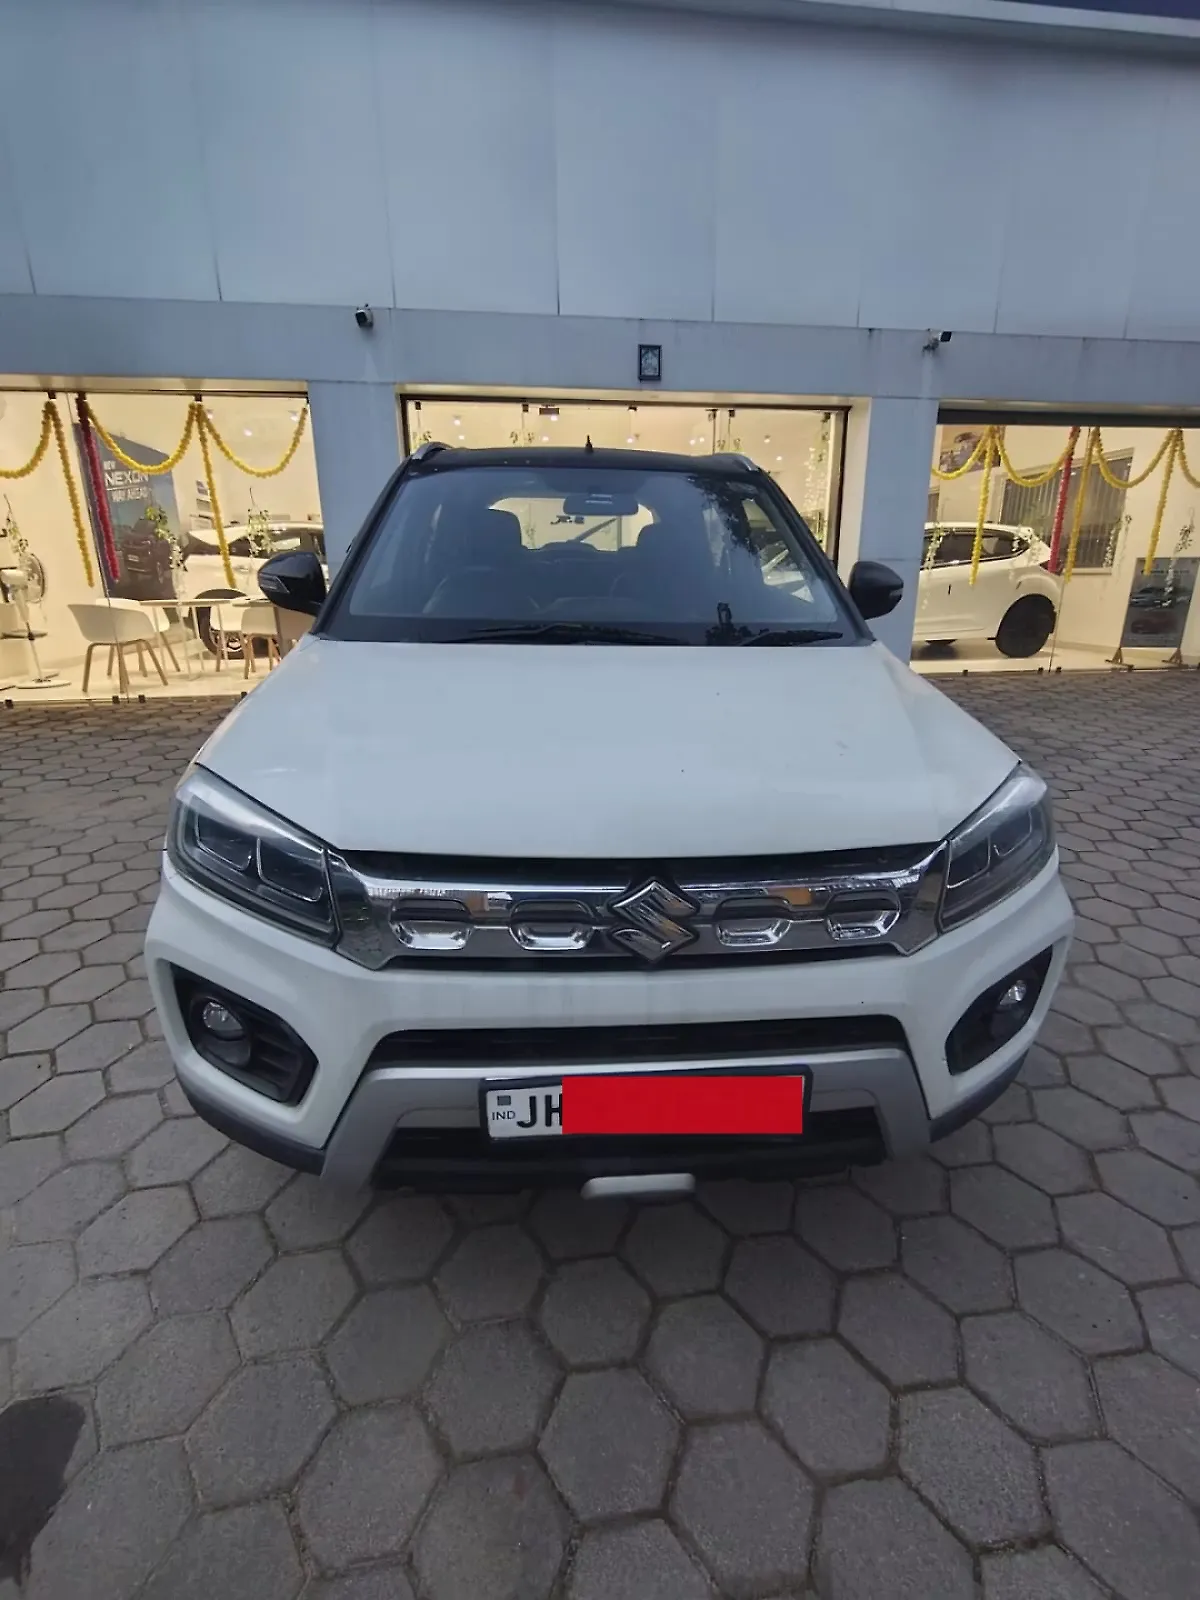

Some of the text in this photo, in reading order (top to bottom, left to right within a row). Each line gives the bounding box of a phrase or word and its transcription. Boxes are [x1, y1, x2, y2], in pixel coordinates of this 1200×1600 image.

[104, 470, 149, 487] NEXON
[492, 1110, 516, 1120] IND
[516, 1094, 563, 1128] JH
